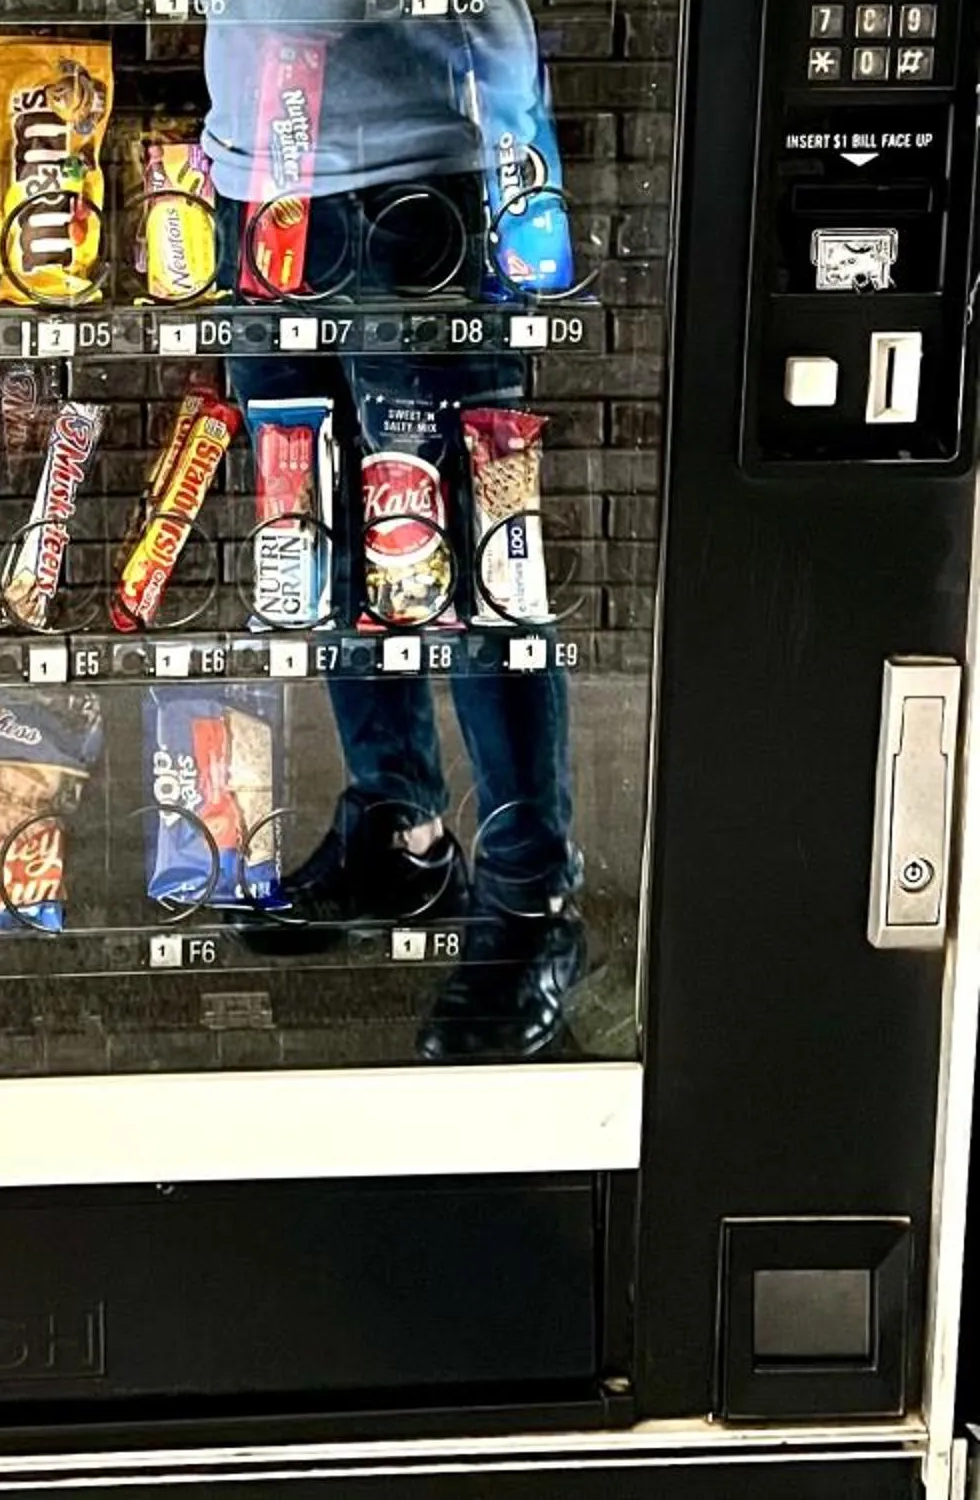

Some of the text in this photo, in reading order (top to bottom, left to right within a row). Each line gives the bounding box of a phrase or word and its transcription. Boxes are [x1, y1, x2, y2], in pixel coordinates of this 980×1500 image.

[820, 8, 832, 33] 7
[907, 7, 921, 32] 9
[860, 50, 873, 75] 0
[282, 89, 311, 153] Nutter
[785, 132, 934, 149] INSERT $1 BILL FACE UP
[498, 130, 529, 216] OREO
[167, 207, 193, 290] Newtons
[79, 322, 112, 348] D5
[200, 320, 232, 346] D6
[320, 318, 353, 344] D7
[451, 318, 484, 343] D8
[550, 318, 583, 343] D9
[37, 415, 93, 600] 3 Musketeers
[363, 479, 432, 520] Kar's
[260, 532, 280, 615] NUTRI
[280, 533, 301, 617] GRAIN
[74, 651, 100, 676] E5
[200, 649, 225, 673] E6
[315, 646, 338, 671] E7
[428, 644, 452, 669] E8
[555, 642, 579, 668] E9
[189, 939, 216, 964] F6
[433, 932, 460, 957] F8
